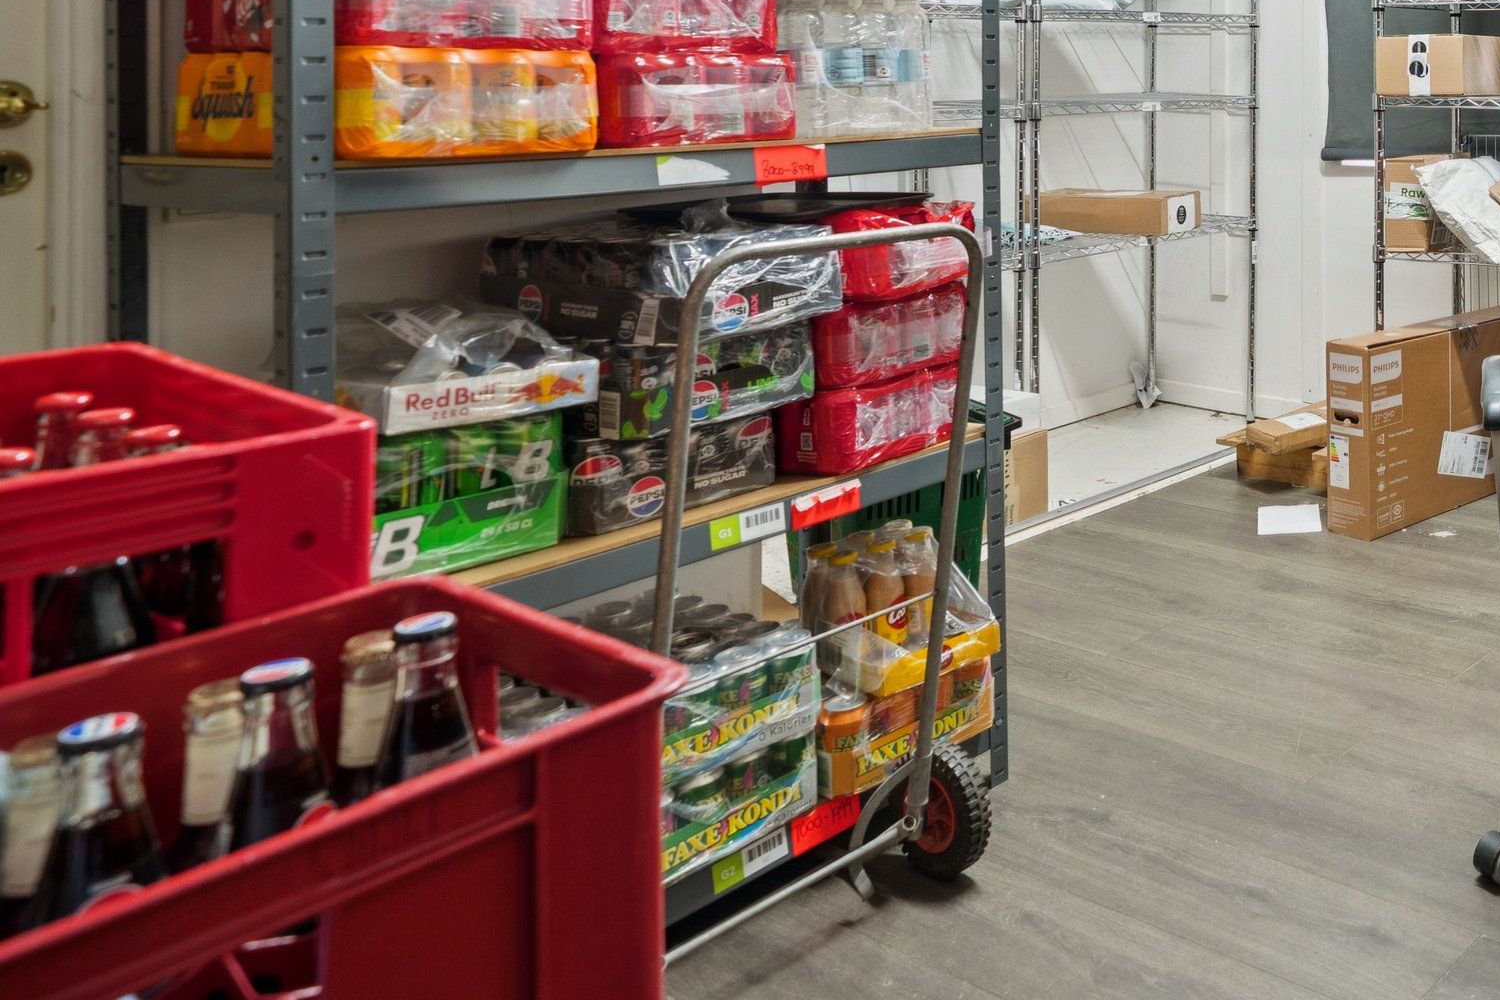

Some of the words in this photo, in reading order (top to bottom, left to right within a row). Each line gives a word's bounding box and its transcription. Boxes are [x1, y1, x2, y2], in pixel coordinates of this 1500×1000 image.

[773, 300, 787, 308] NO
[1332, 363, 1360, 374] PHILIPS
[1373, 360, 1399, 374] PHILIPS
[405, 389, 449, 412] Red
[432, 408, 469, 420] ZERO
[513, 440, 553, 482] B
[694, 479, 710, 490] NO
[711, 471, 747, 486] SUGAR
[629, 489, 665, 505] PEPSI
[718, 528, 732, 540] G1
[370, 514, 426, 579] B
[769, 713, 812, 736] Kalorier
[662, 727, 714, 763] AXE
[856, 734, 911, 777] FAXE
[933, 705, 979, 740] ONDI
[662, 826, 721, 872] FAXE
